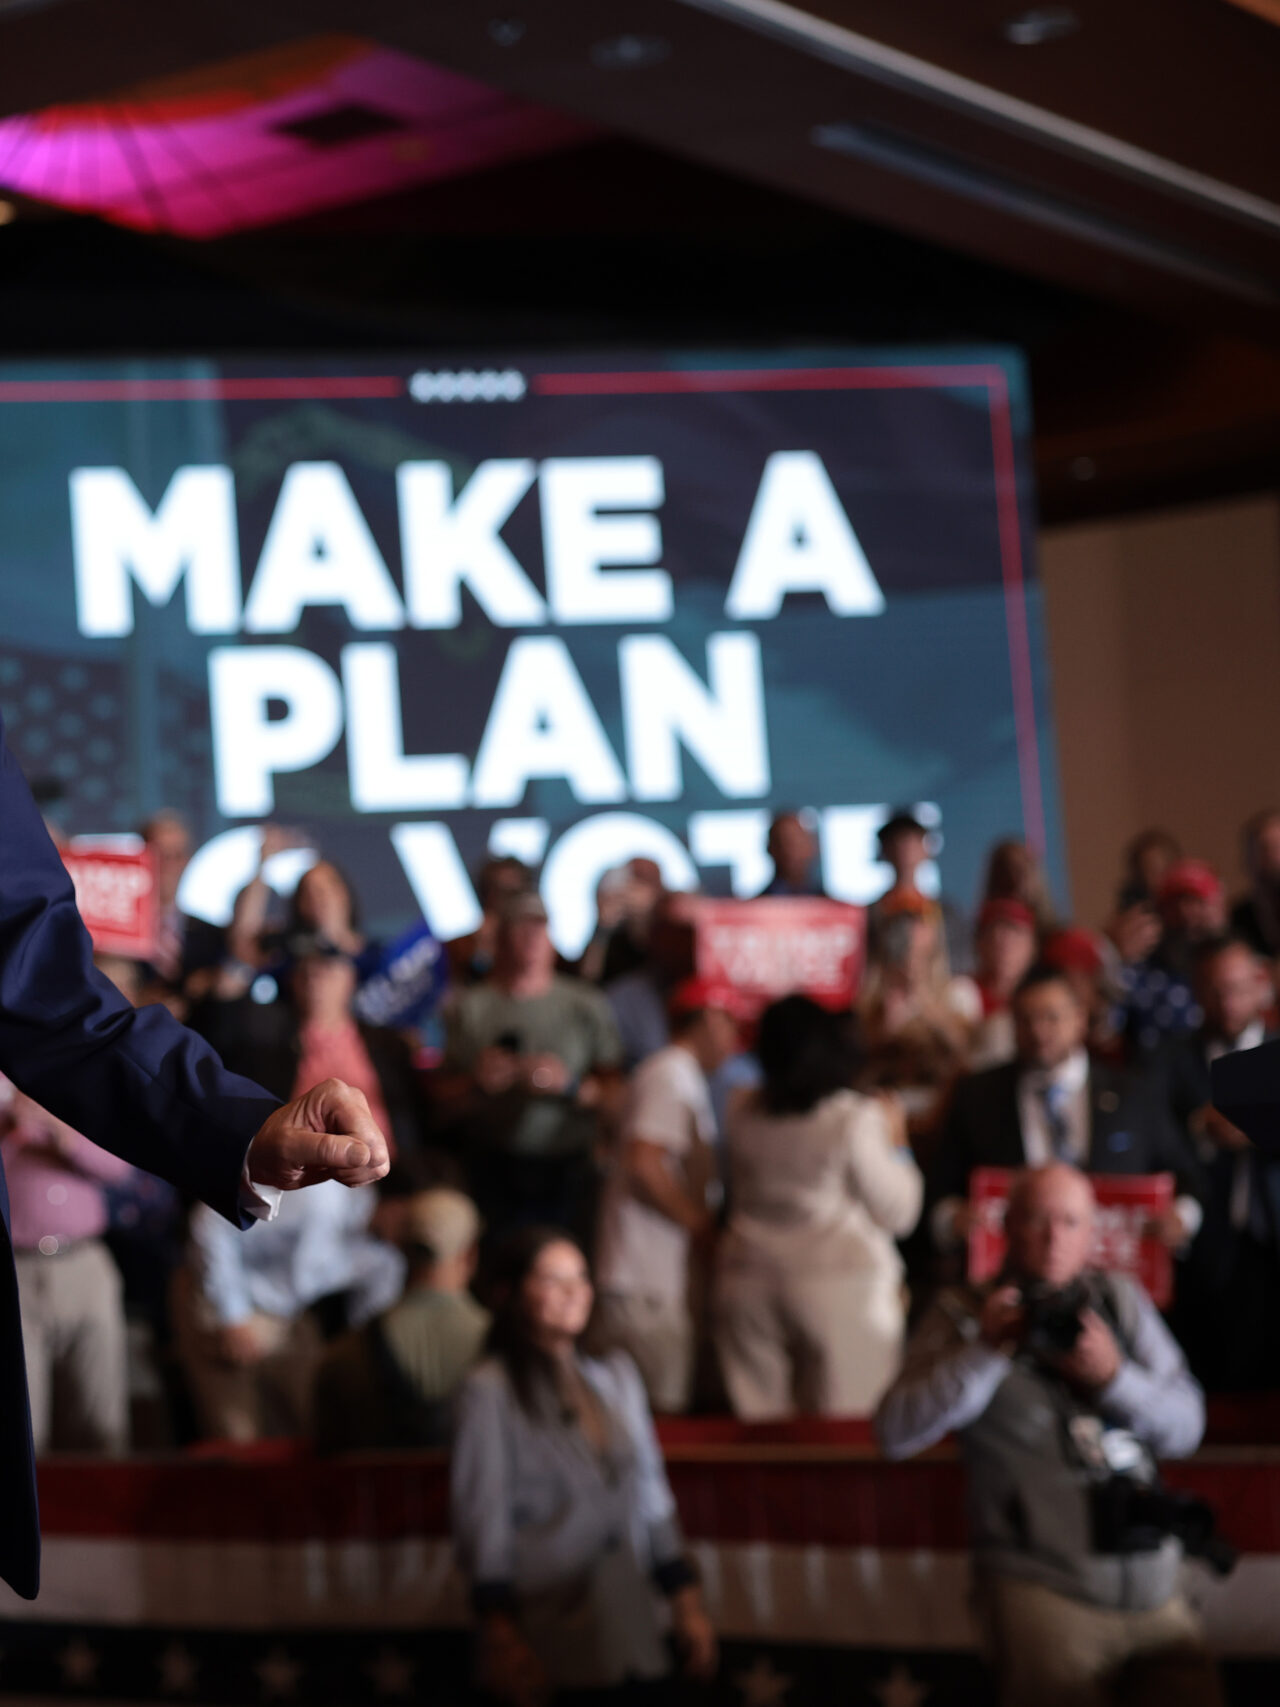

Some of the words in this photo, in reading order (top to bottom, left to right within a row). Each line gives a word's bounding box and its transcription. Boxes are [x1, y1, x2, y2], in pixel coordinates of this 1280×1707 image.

[69, 456, 673, 637] MAKE
[727, 450, 883, 619] A
[208, 632, 771, 817] PLAN
